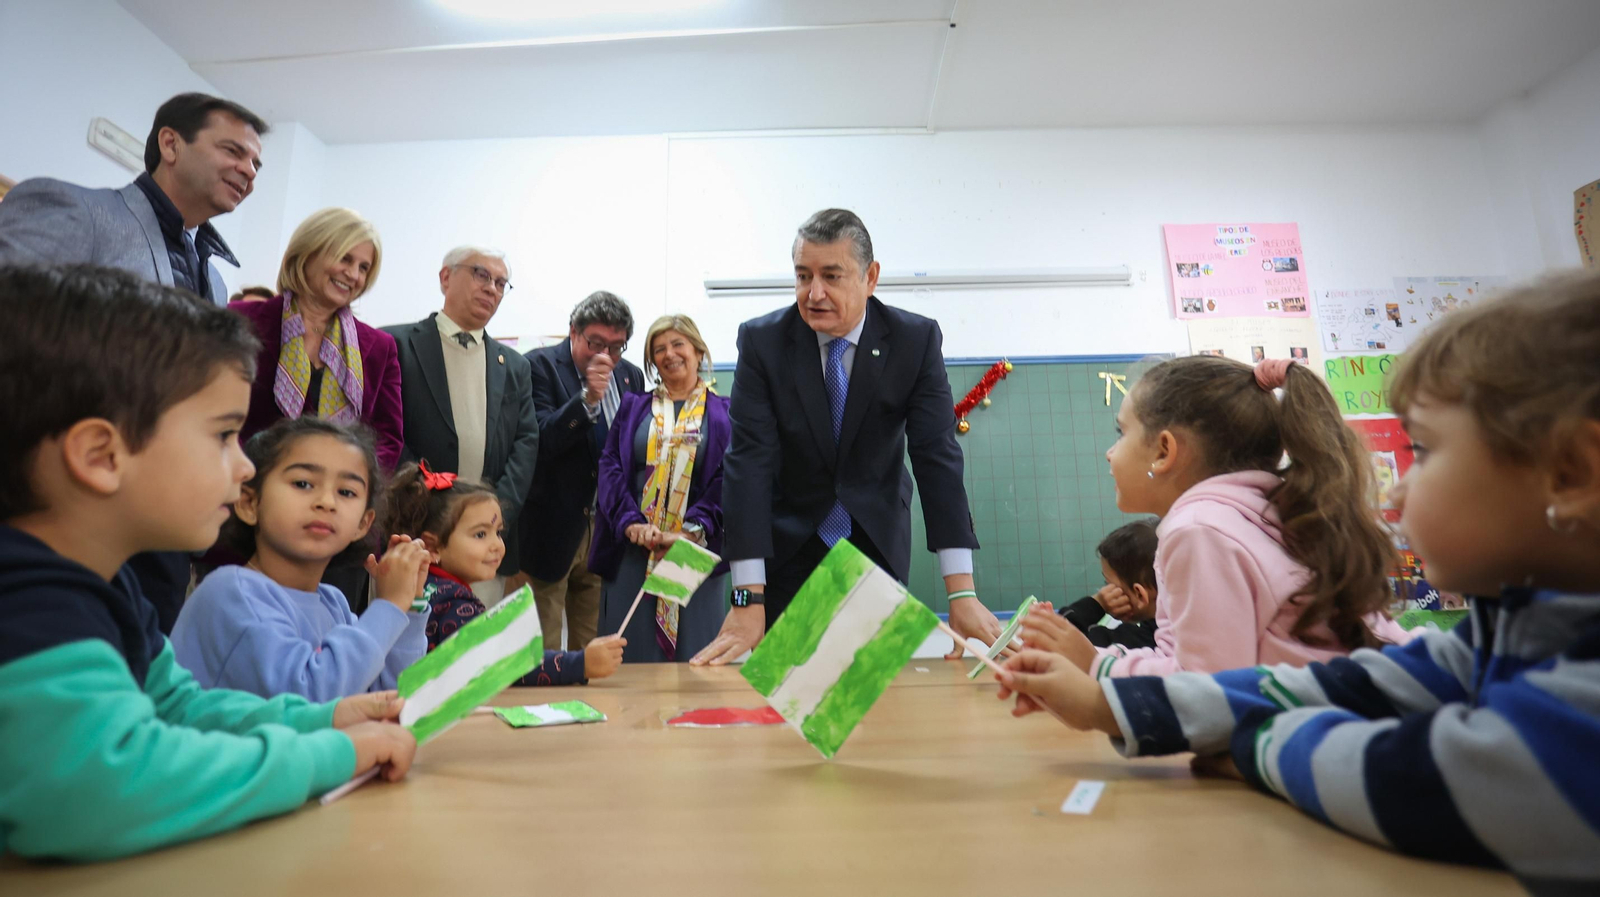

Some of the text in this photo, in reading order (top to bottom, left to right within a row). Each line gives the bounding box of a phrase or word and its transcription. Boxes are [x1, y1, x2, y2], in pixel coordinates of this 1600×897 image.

[1218, 226, 1250, 234] TIPOS DE
[1215, 236, 1256, 245] MUSEOS EN
[1286, 238, 1298, 247] DE
[1325, 354, 1400, 380] RINCÓ
[1334, 389, 1391, 410] PROYE
